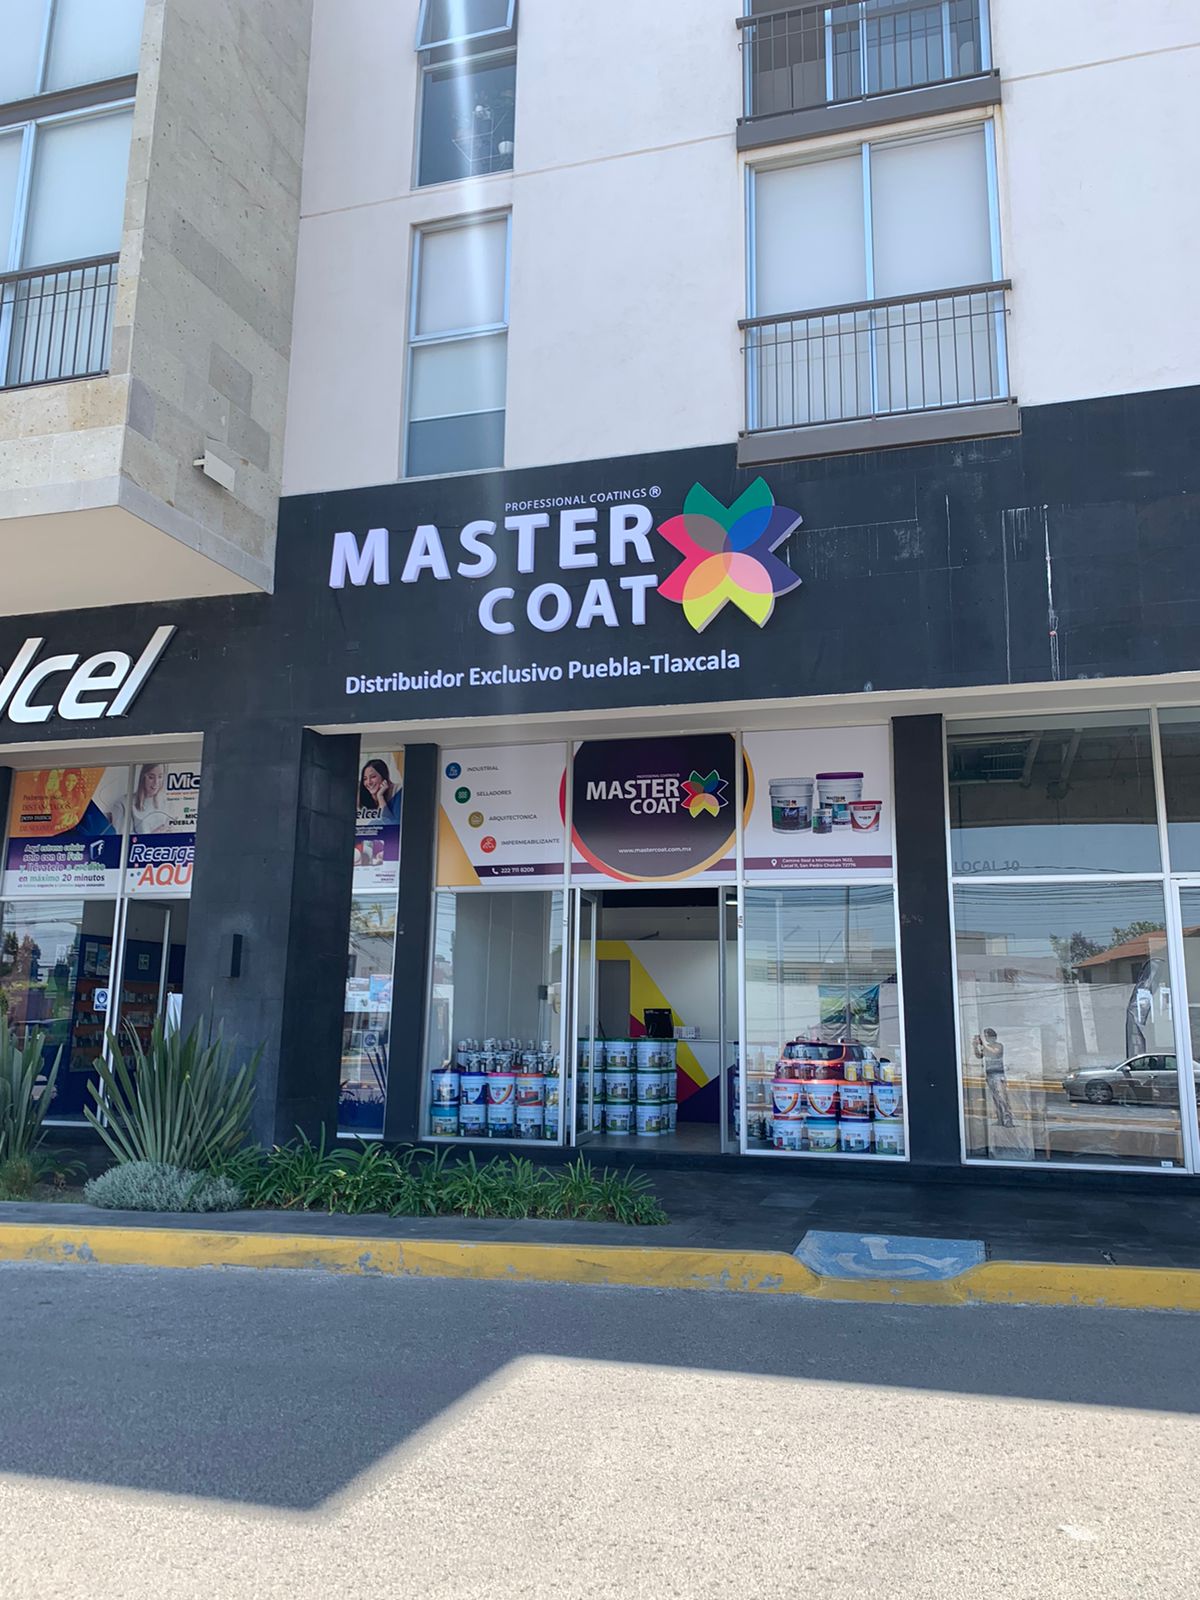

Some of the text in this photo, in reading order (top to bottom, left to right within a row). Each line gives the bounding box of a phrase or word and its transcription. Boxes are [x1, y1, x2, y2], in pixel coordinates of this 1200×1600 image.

[504, 495, 587, 512] PROFESSIONAL
[589, 487, 647, 503] COATINGS
[328, 503, 656, 589] MASTER
[478, 574, 659, 635] COAT
[0, 624, 178, 723] lcel
[345, 649, 741, 695] Distribuidor Exclusivo Puebla-Tlaxcala
[476, 789, 512, 797] SELLADORES
[586, 778, 680, 801] MASTER
[630, 798, 681, 814] COAT
[501, 838, 560, 846] IMPERMEABILIZANTE
[62, 873, 73, 882] 20
[74, 873, 105, 882] minutos
[954, 860, 1020, 872] LOCAL 10
